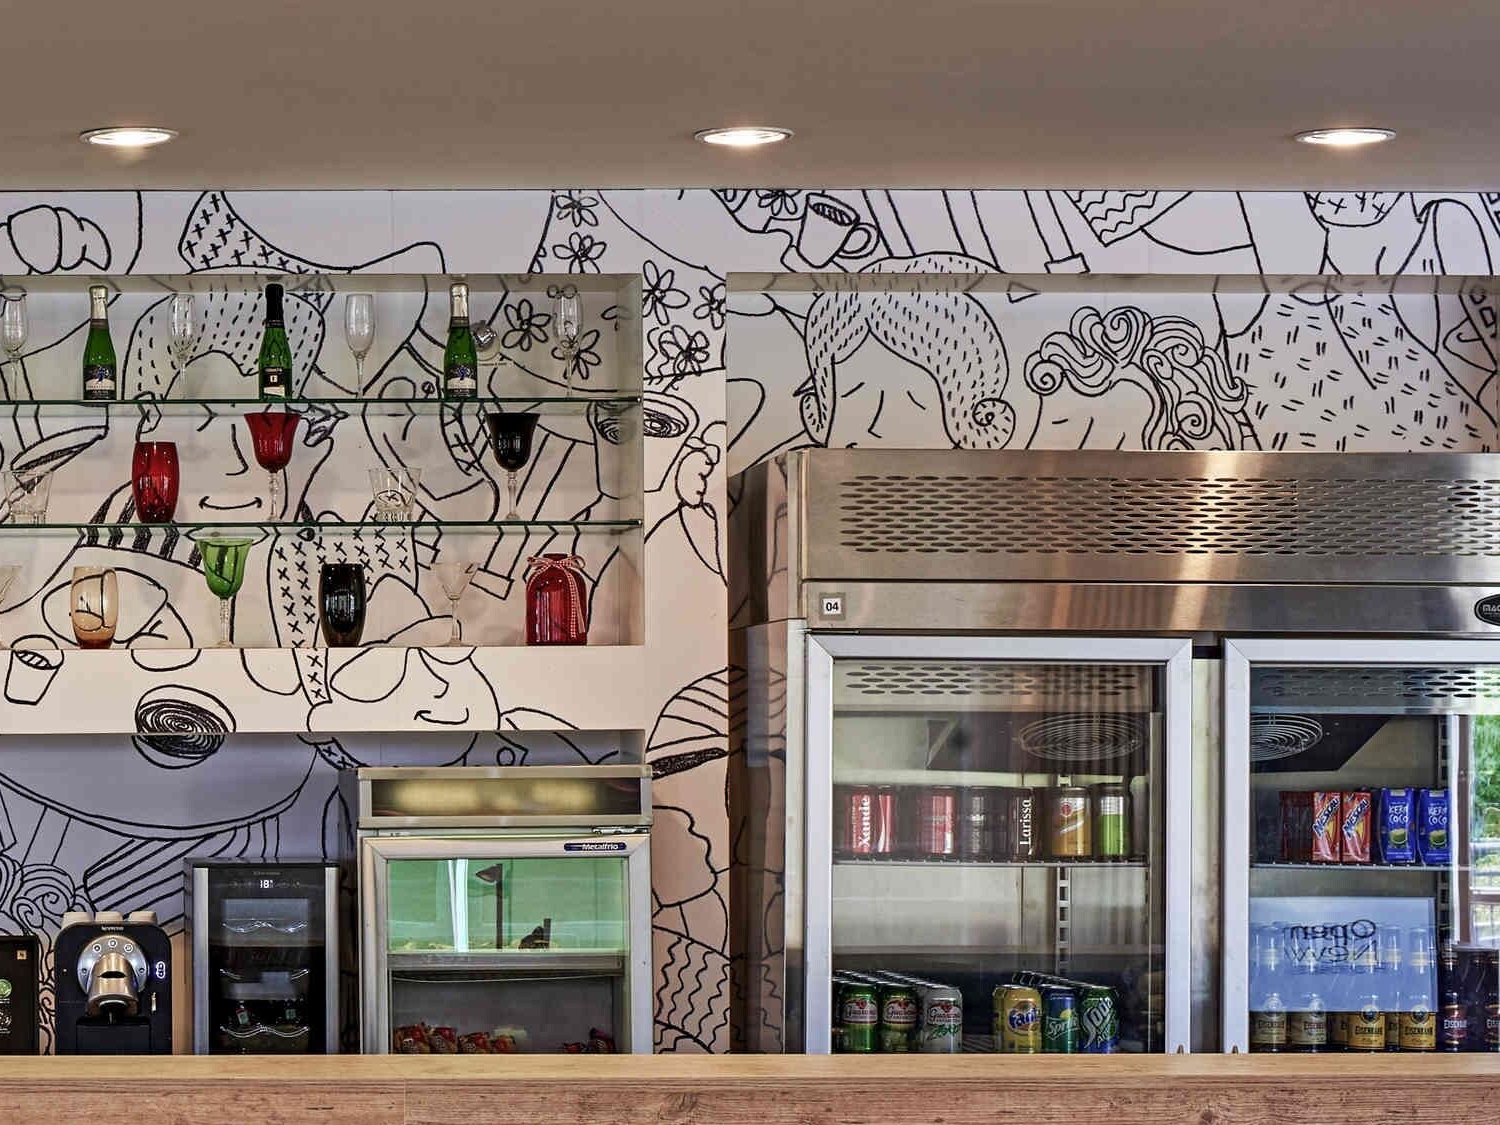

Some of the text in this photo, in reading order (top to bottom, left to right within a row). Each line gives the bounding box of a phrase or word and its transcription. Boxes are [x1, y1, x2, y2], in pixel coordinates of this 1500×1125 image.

[826, 602, 838, 611] 04
[859, 797, 871, 848] Xande
[1019, 799, 1032, 846] Larissa
